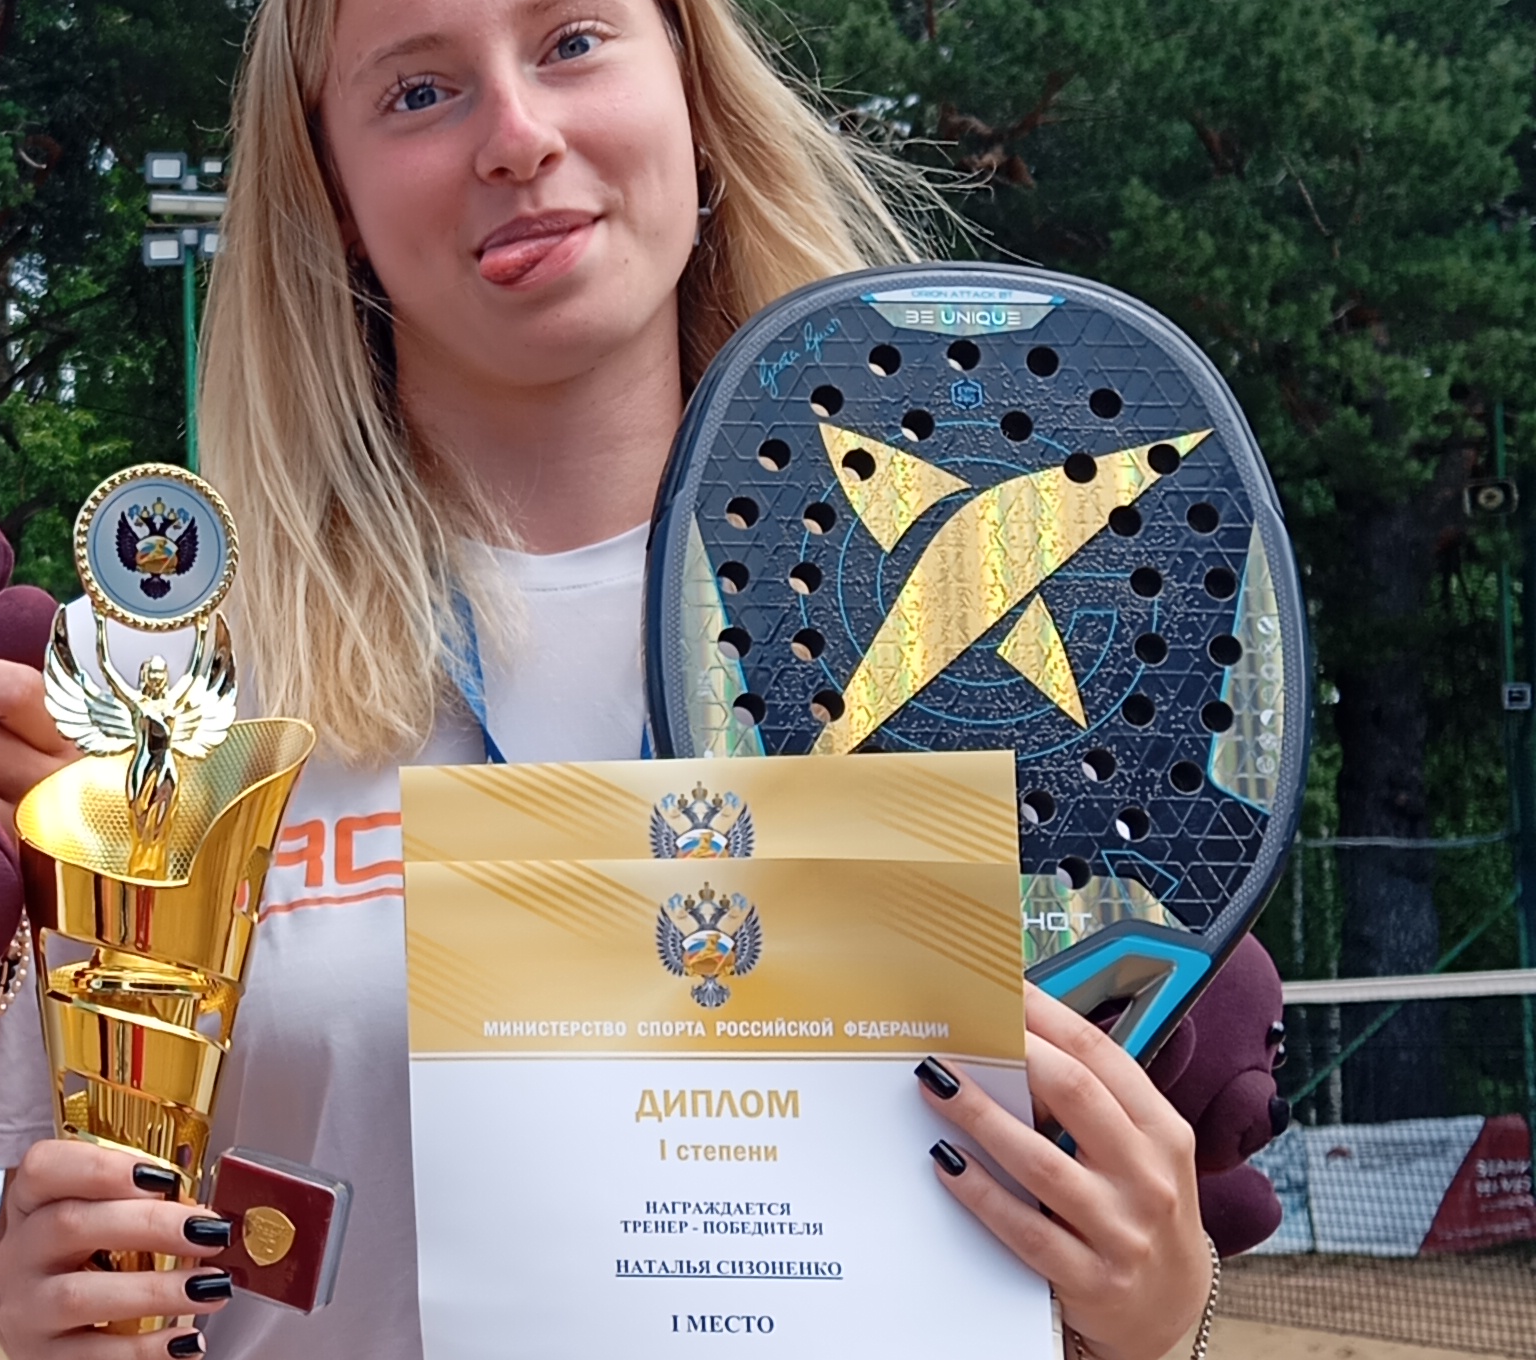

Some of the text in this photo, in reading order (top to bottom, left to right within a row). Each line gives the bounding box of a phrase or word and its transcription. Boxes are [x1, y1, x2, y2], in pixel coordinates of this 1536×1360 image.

[951, 290, 995, 298] ATTACK
[905, 309, 1021, 326] BE UNIQUE
[1023, 911, 1093, 931] HOT
[483, 1018, 950, 1039] МИНИСТЕРСТВО СПОРТА РОССИЙСКОЙ ФЕДЕРАЦИИ
[635, 1089, 800, 1123] ДИПЛОМ
[676, 1144, 778, 1162] степени
[645, 1200, 791, 1217] НАГРАЖДАЕТСЯ
[620, 1220, 689, 1234] ТРЕНЕР
[703, 1220, 824, 1237] ПОБЕДИТЕЛЯ
[615, 1258, 843, 1277] НАТАЛЬЯ СИЗОНЕНКО
[686, 1314, 775, 1334] МЕСТО
